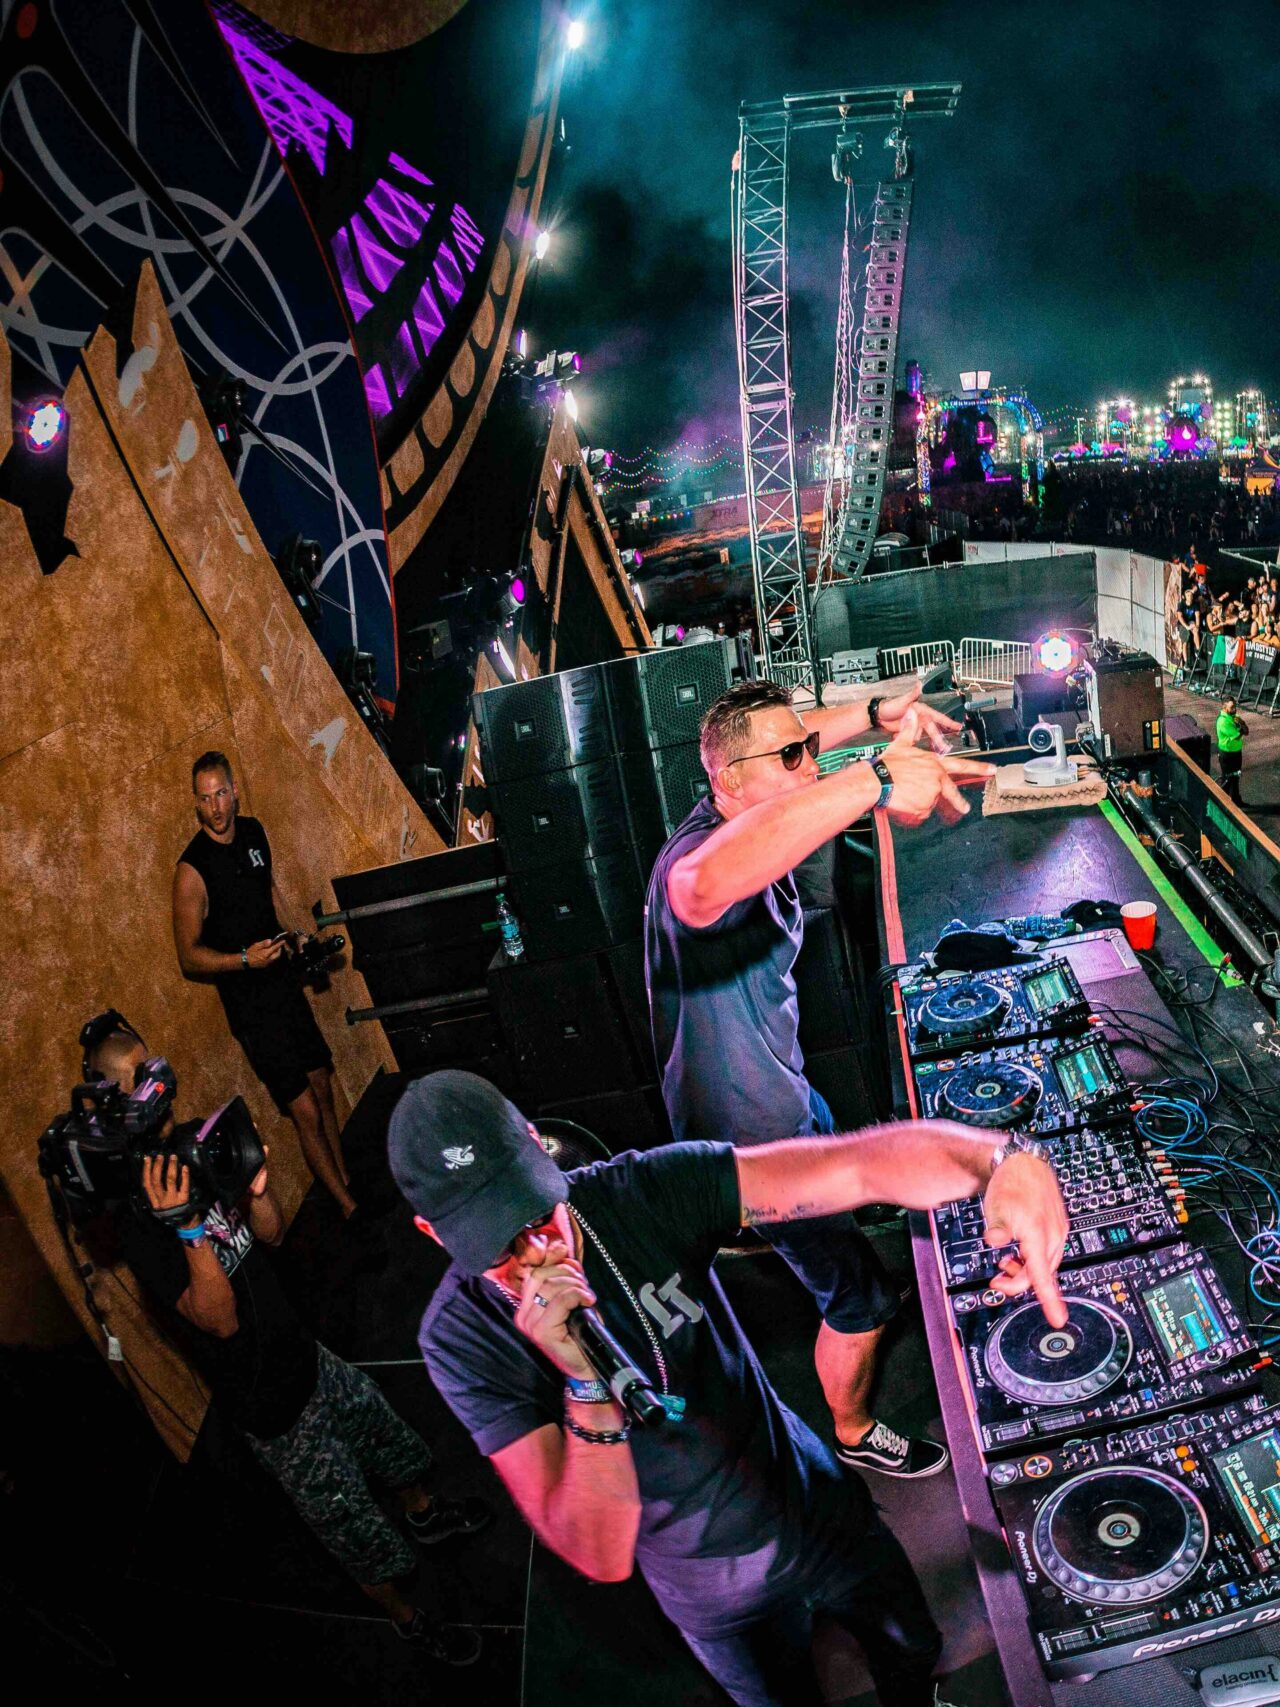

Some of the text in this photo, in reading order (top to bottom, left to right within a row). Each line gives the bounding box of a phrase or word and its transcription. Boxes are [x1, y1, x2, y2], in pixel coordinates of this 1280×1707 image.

[970, 1346, 981, 1378] Pioneer
[1015, 1531, 1037, 1583] Pioneer DJ
[1132, 1617, 1246, 1658] Pioneer
